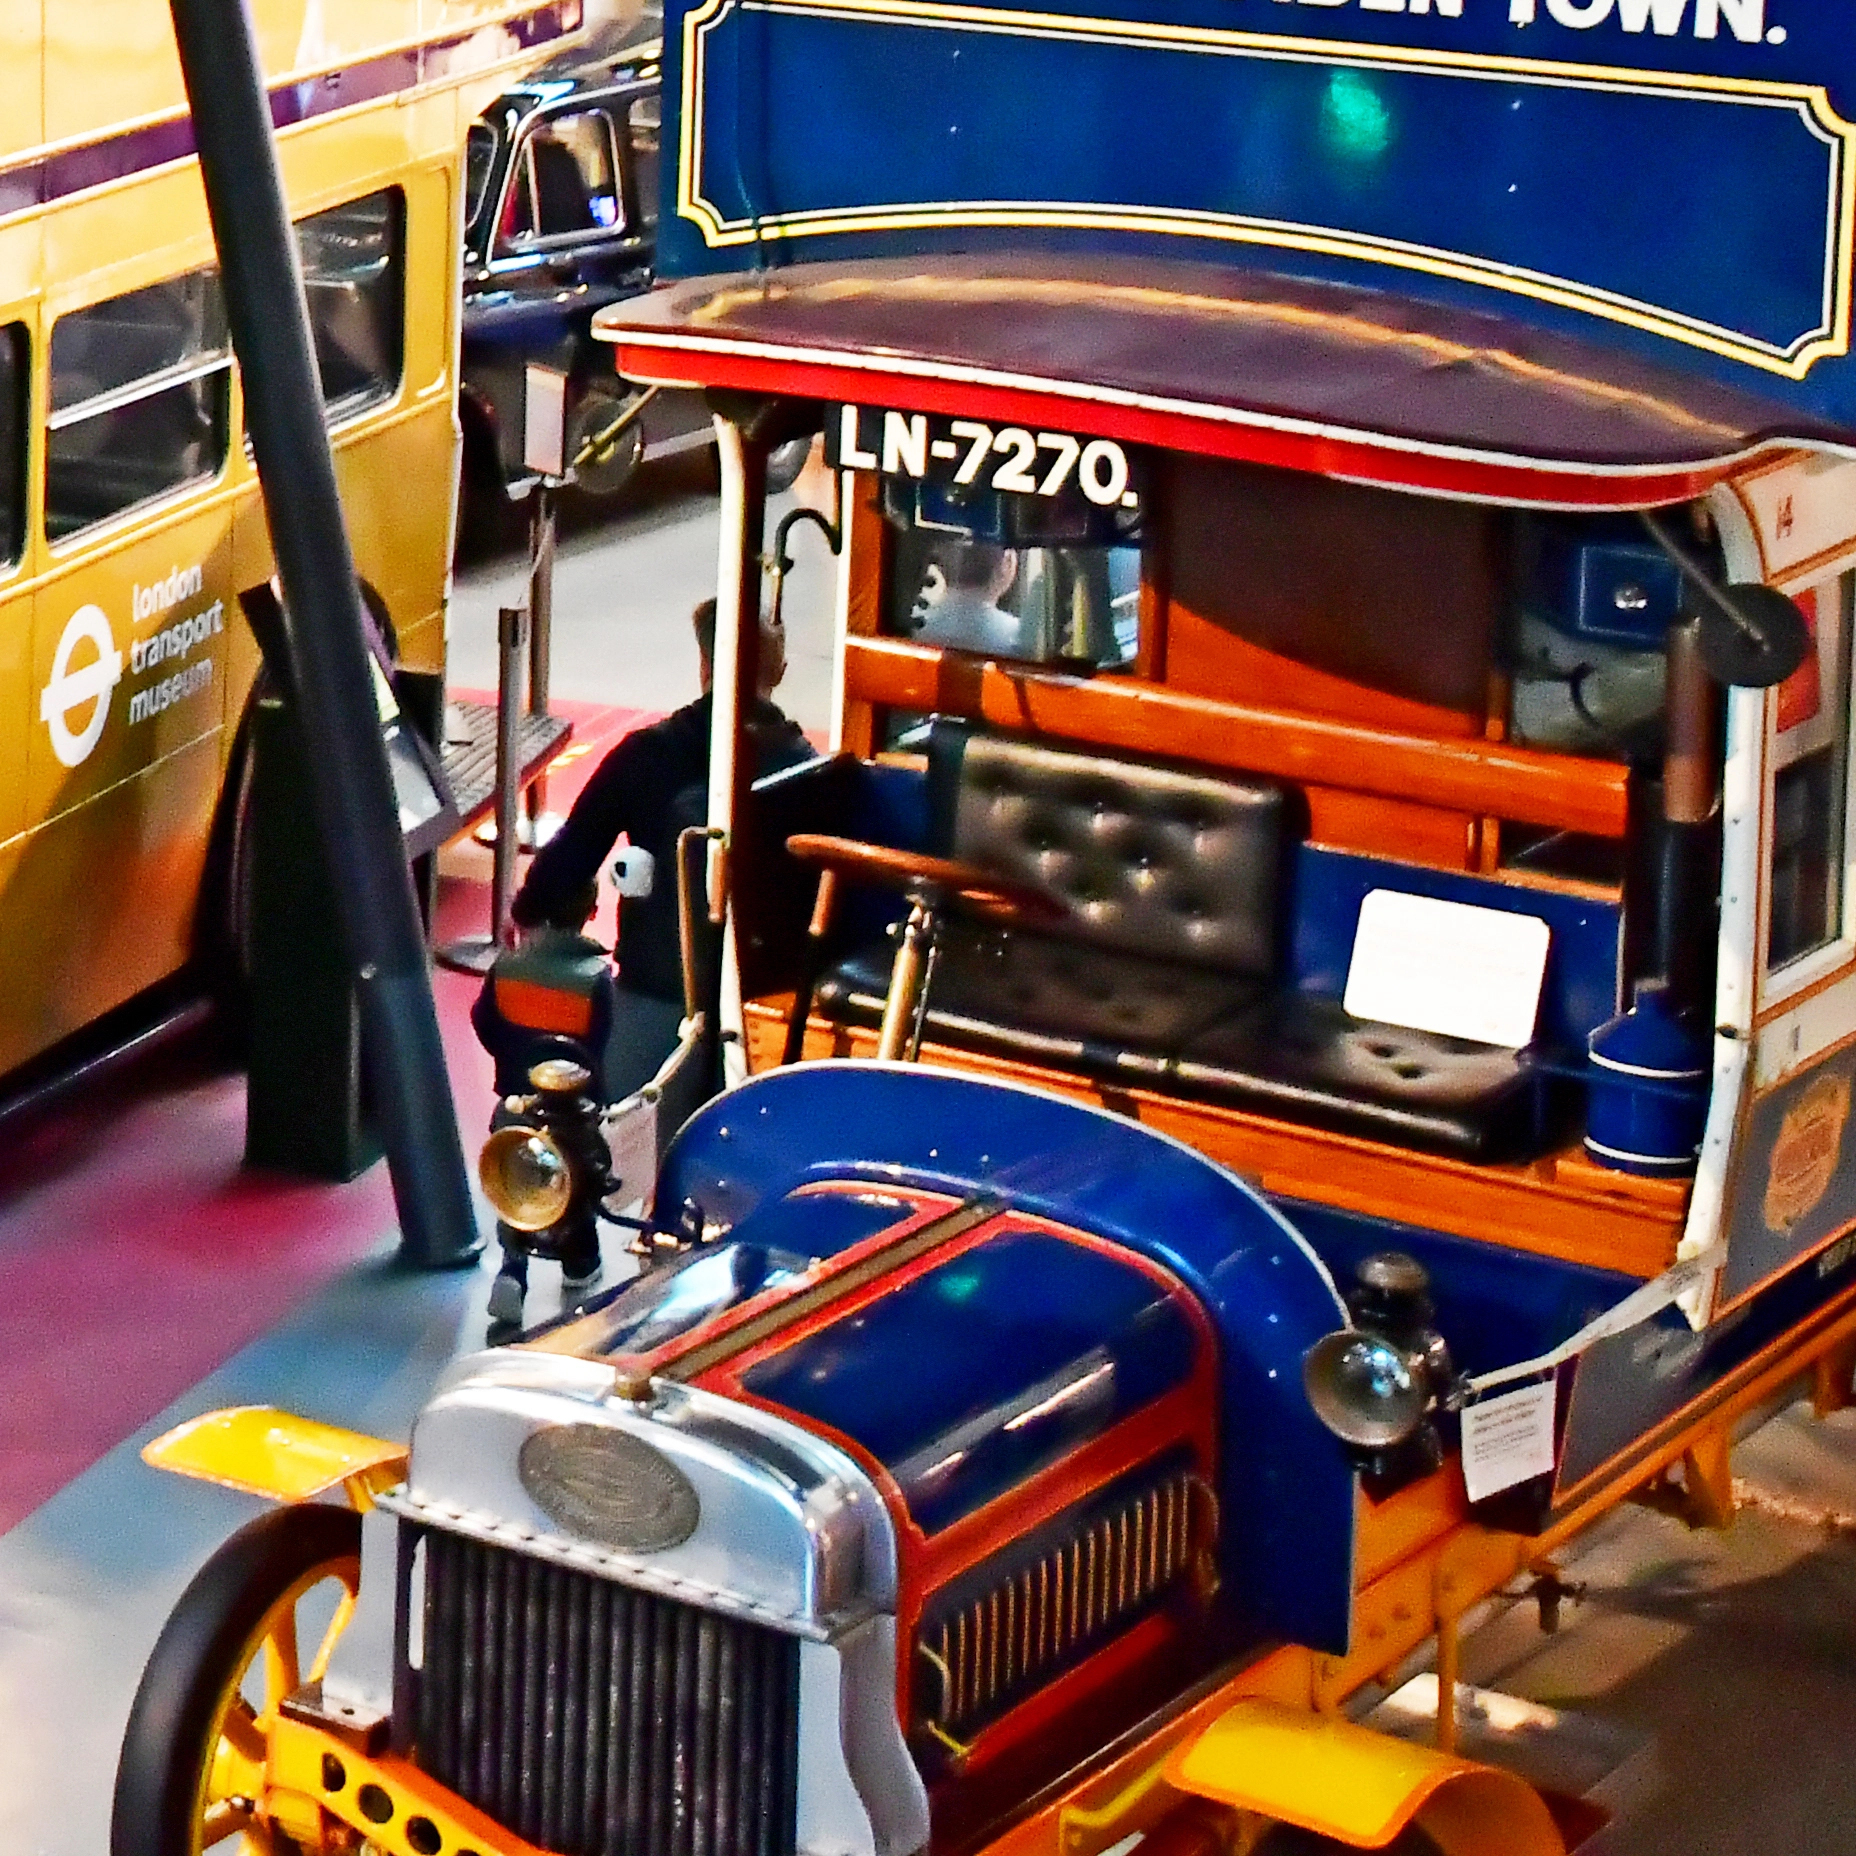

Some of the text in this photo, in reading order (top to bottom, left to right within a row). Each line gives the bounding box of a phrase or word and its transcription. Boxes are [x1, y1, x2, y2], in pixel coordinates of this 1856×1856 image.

[839, 403, 1138, 508] LN-7270.
[132, 564, 202, 624] london
[130, 598, 224, 675] transport
[128, 658, 213, 726] museum
